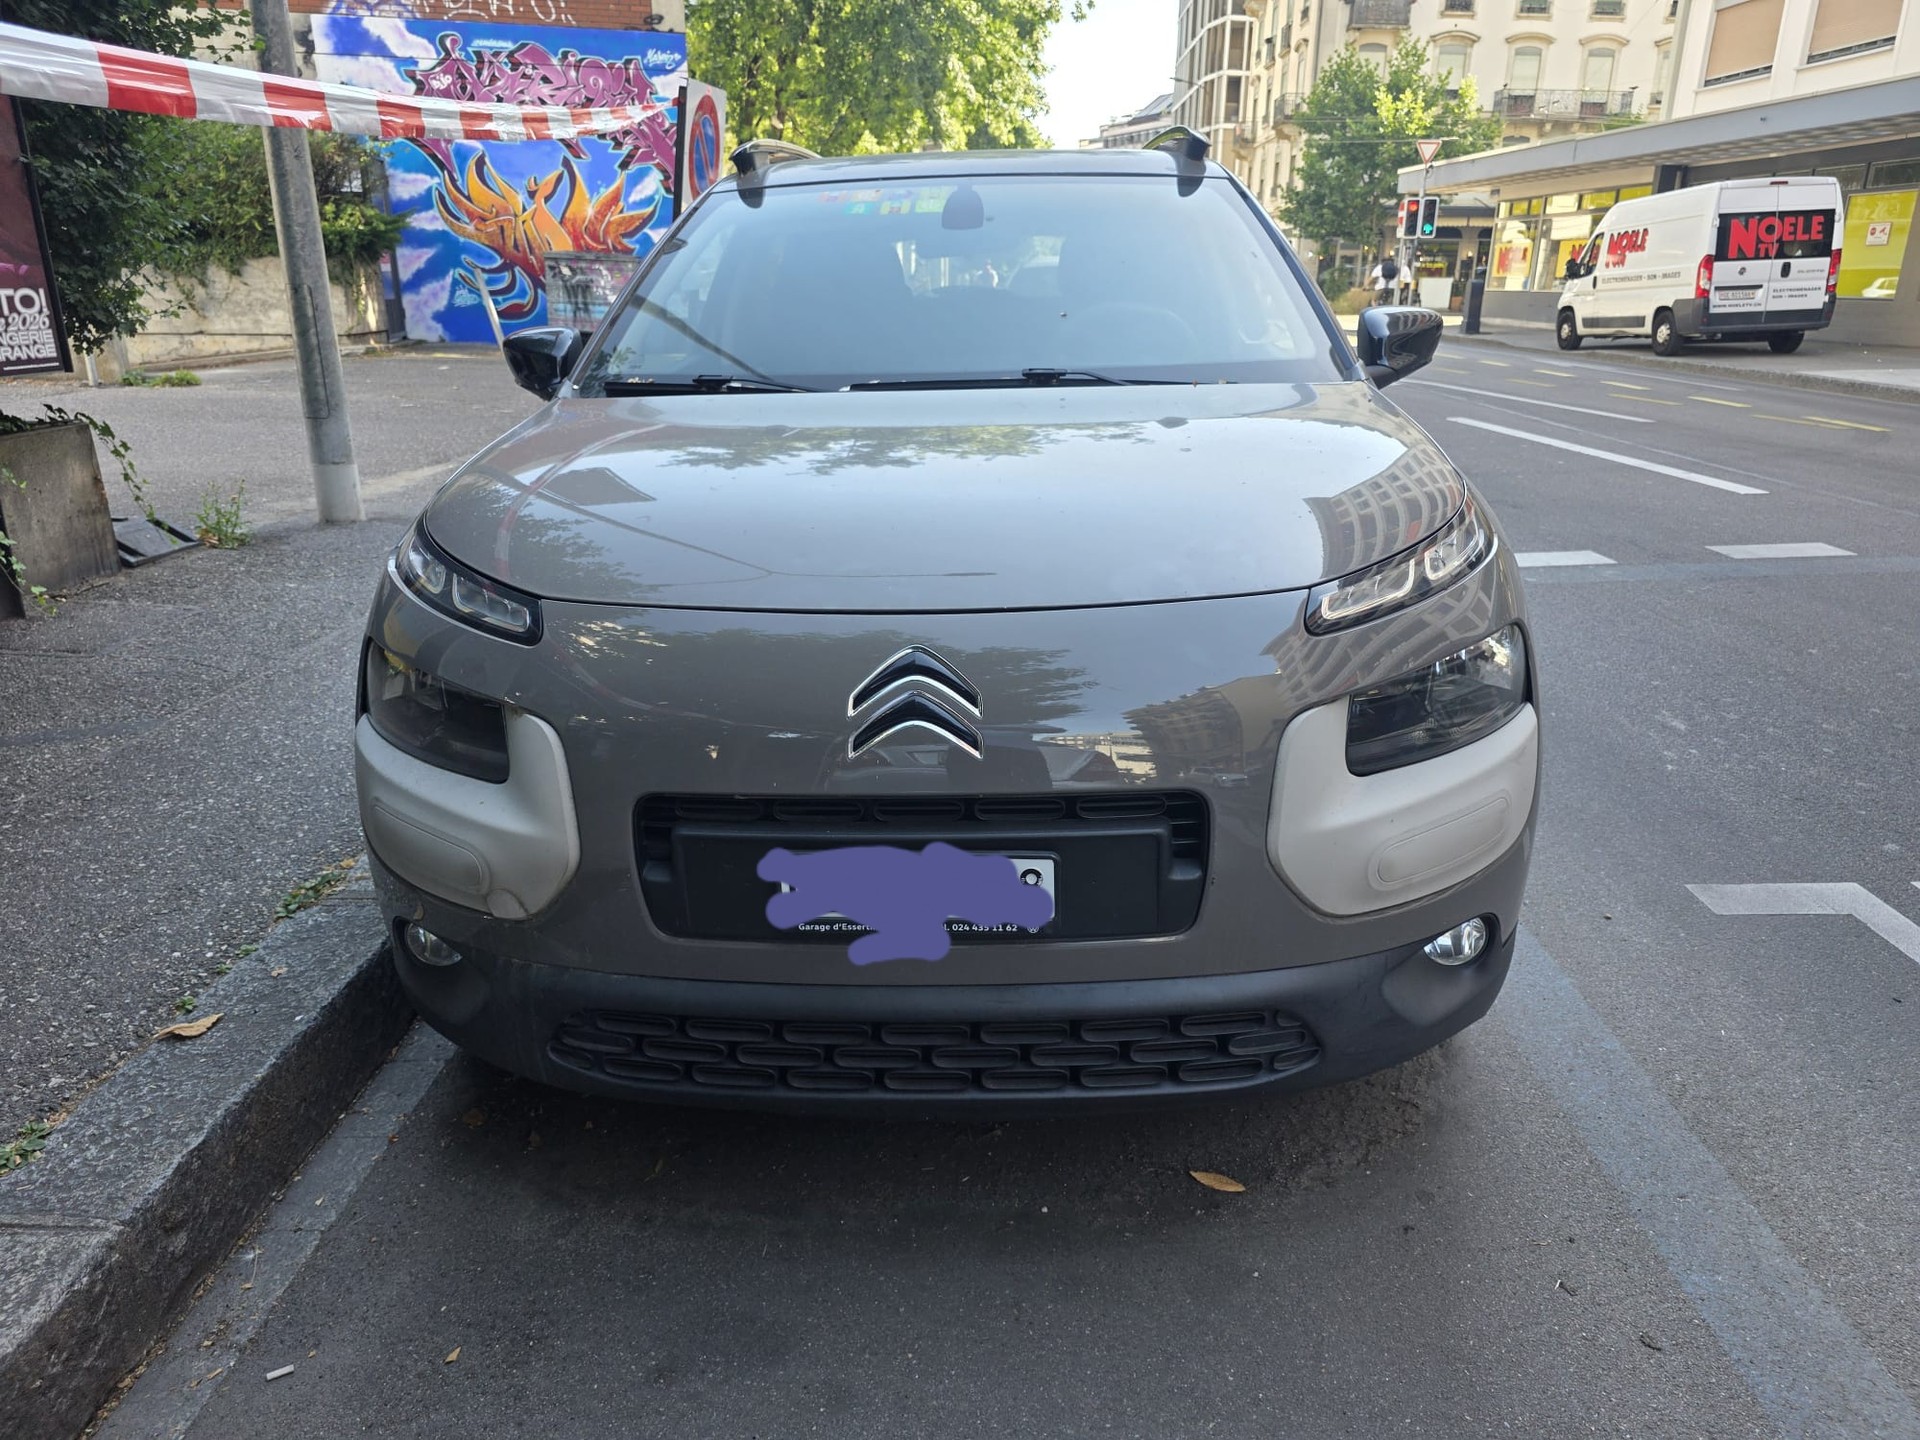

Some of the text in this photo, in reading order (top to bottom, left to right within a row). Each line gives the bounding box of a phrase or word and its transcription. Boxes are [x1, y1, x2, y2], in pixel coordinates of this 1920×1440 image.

[1727, 215, 1825, 259] NOELE
[1605, 228, 1649, 269] NOELE
[1758, 243, 1780, 258] TV
[7, 312, 50, 331] 2026
[798, 923, 831, 932] Garage
[952, 923, 970, 931] 024
[1006, 923, 1018, 931] 62
